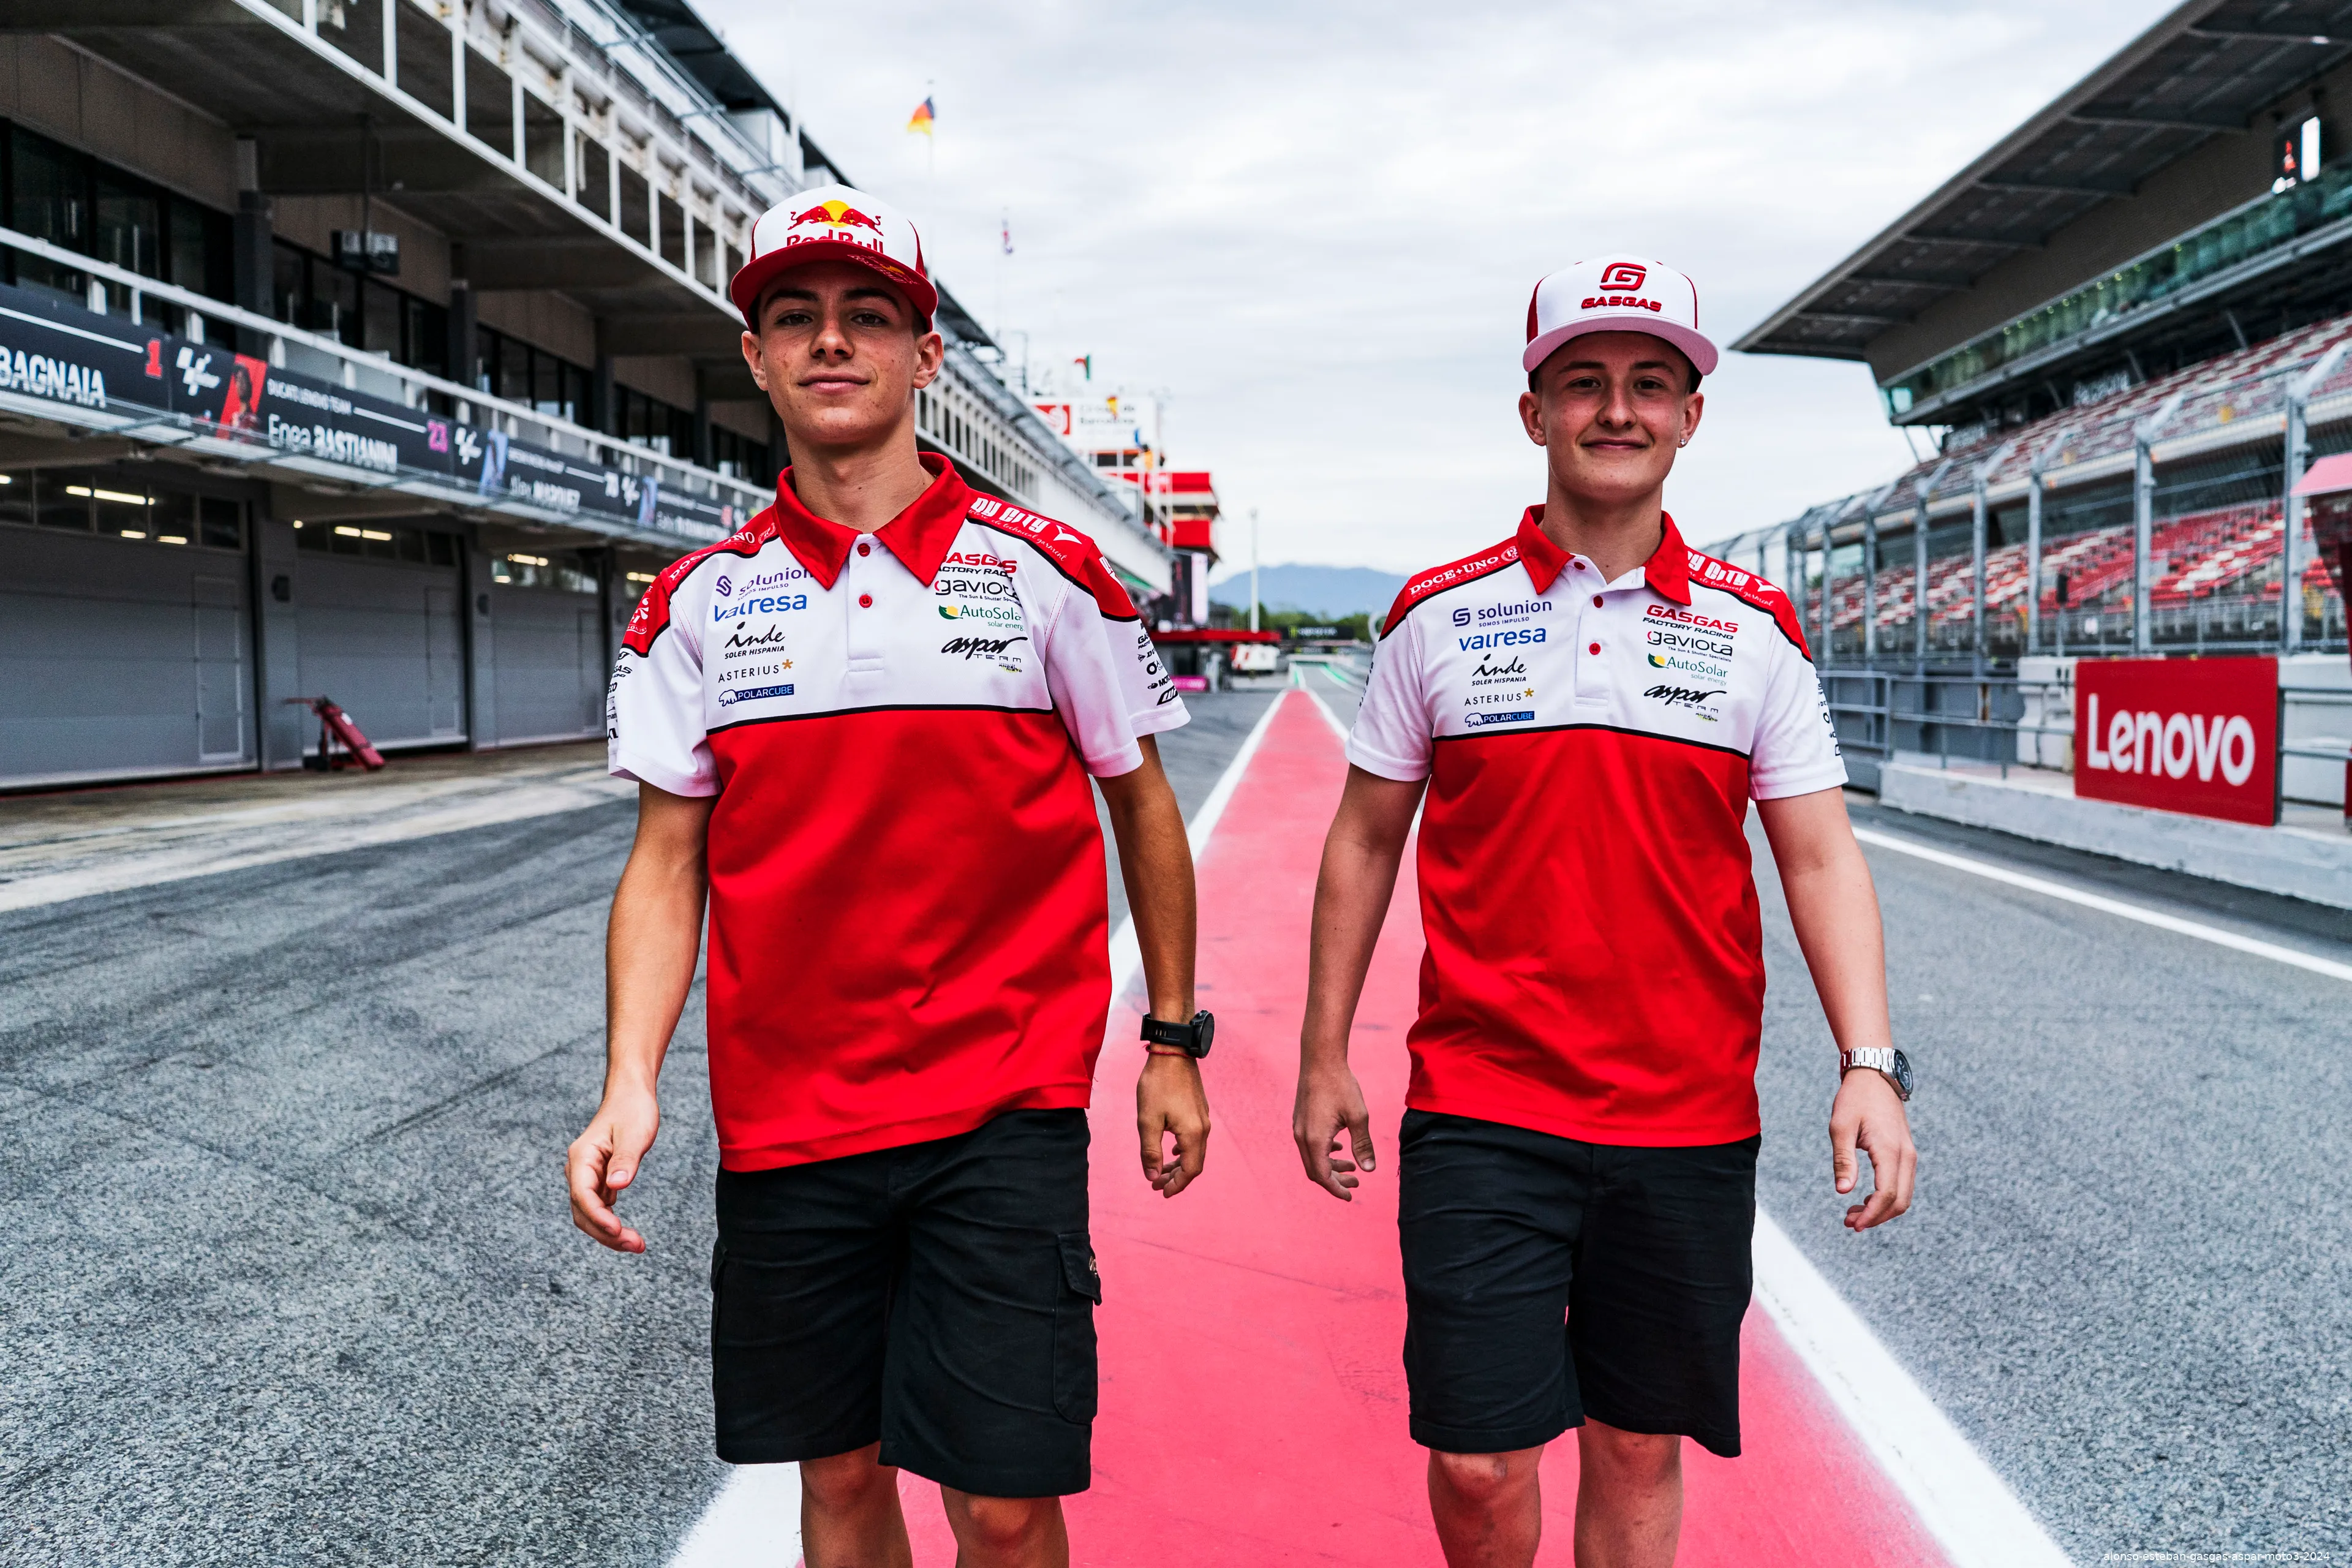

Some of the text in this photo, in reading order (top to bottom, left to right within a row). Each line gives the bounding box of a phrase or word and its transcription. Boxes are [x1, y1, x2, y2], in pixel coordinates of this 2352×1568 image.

[1581, 296, 1662, 312] GASGAS
[145, 339, 163, 380] 1
[0, 345, 107, 409] BAGNAIA
[427, 418, 448, 454] 23
[1037, 538, 1068, 562] garment
[940, 566, 981, 575] CTORY
[943, 552, 1017, 574] ASGS
[739, 567, 814, 596] solunion
[1409, 556, 1499, 595] DOCE+UNO
[758, 582, 789, 592] IMPULSO
[960, 604, 1022, 620] AutoSola
[1477, 600, 1552, 620] solunion
[1502, 616, 1530, 625] IMPULSO
[1646, 604, 1739, 633] GASGAS
[1005, 622, 1025, 631] energ
[1642, 617, 1734, 640] FACTORY RACING
[725, 646, 785, 660] SOLER HISPANIA
[941, 636, 1028, 660] aspar
[1647, 630, 1733, 657] gaviota
[973, 653, 1021, 663] TEAM
[1667, 656, 1728, 677] AutoSolar
[1707, 676, 1727, 687] energy
[737, 685, 793, 700] POLARCUBE
[1643, 684, 1727, 706] aspar
[1483, 712, 1534, 723] POLARCUBE
[1673, 701, 1719, 714] TEAM
[2087, 693, 2256, 786] Lenovo
